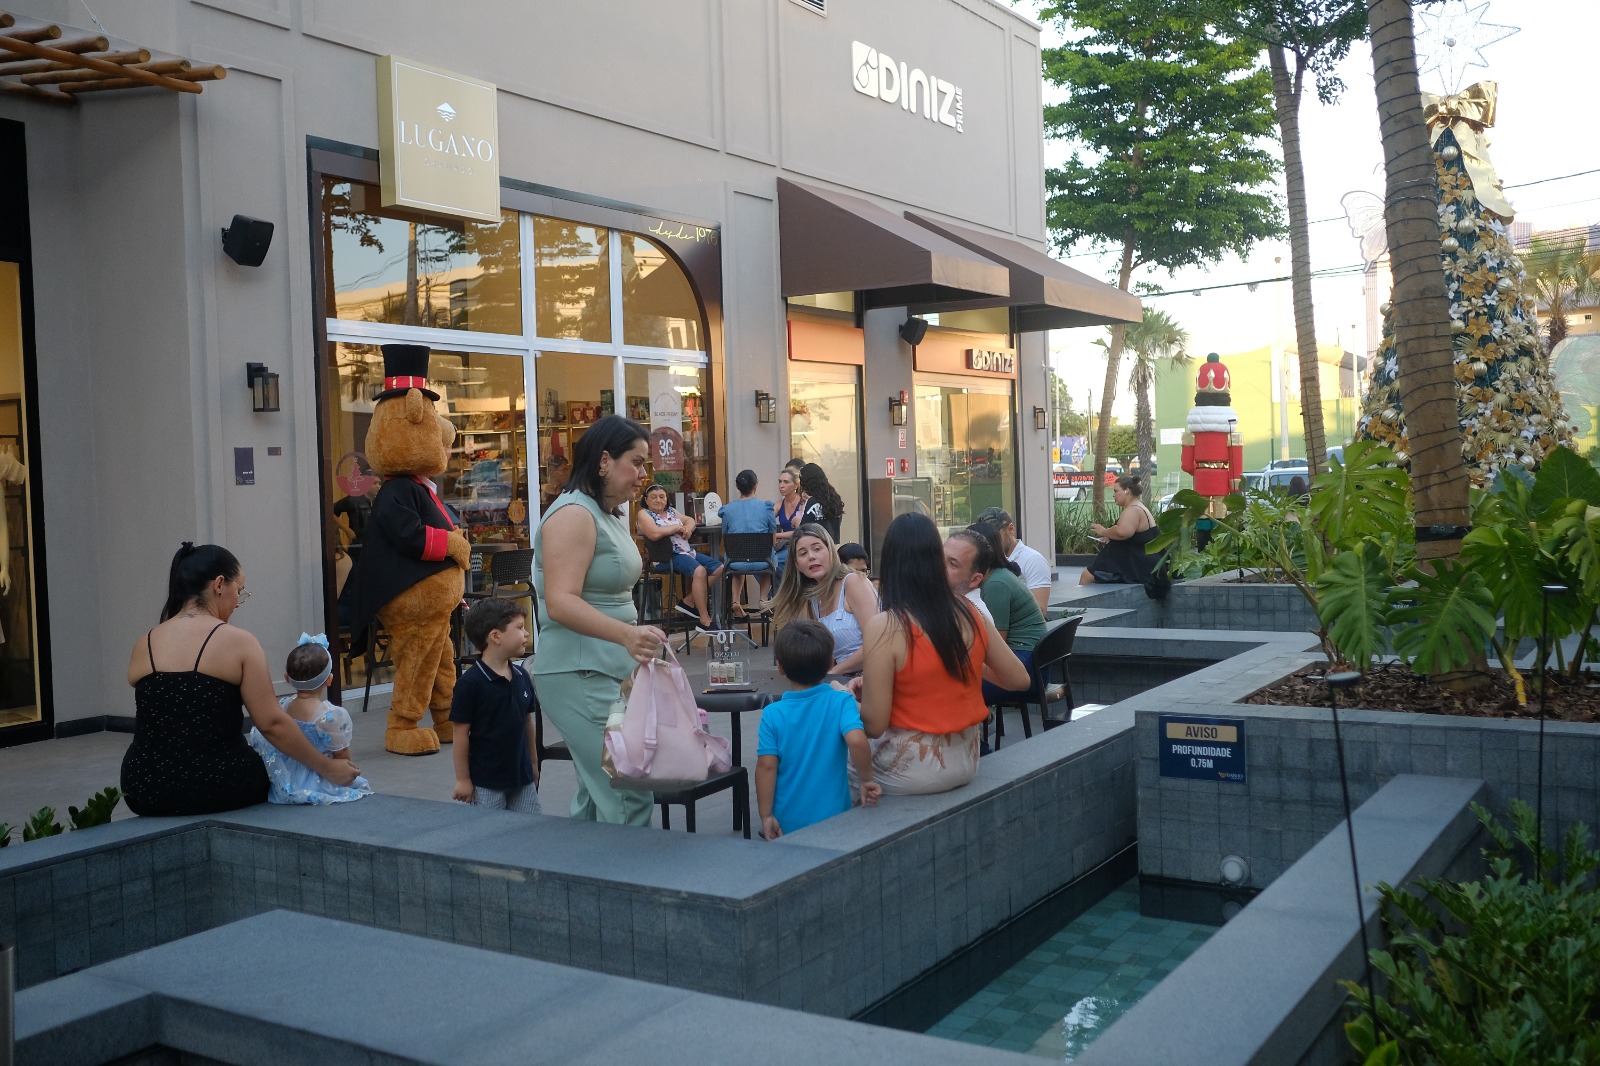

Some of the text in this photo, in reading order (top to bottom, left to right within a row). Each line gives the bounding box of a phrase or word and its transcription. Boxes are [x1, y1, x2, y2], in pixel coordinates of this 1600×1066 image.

[878, 52, 957, 128] DINIZ
[956, 86, 964, 133] PRIME
[400, 120, 493, 162] LUGANO
[982, 350, 1012, 373] DINIZ
[1185, 725, 1218, 739] AVISO
[1172, 744, 1232, 758] PROFUNDIDADE
